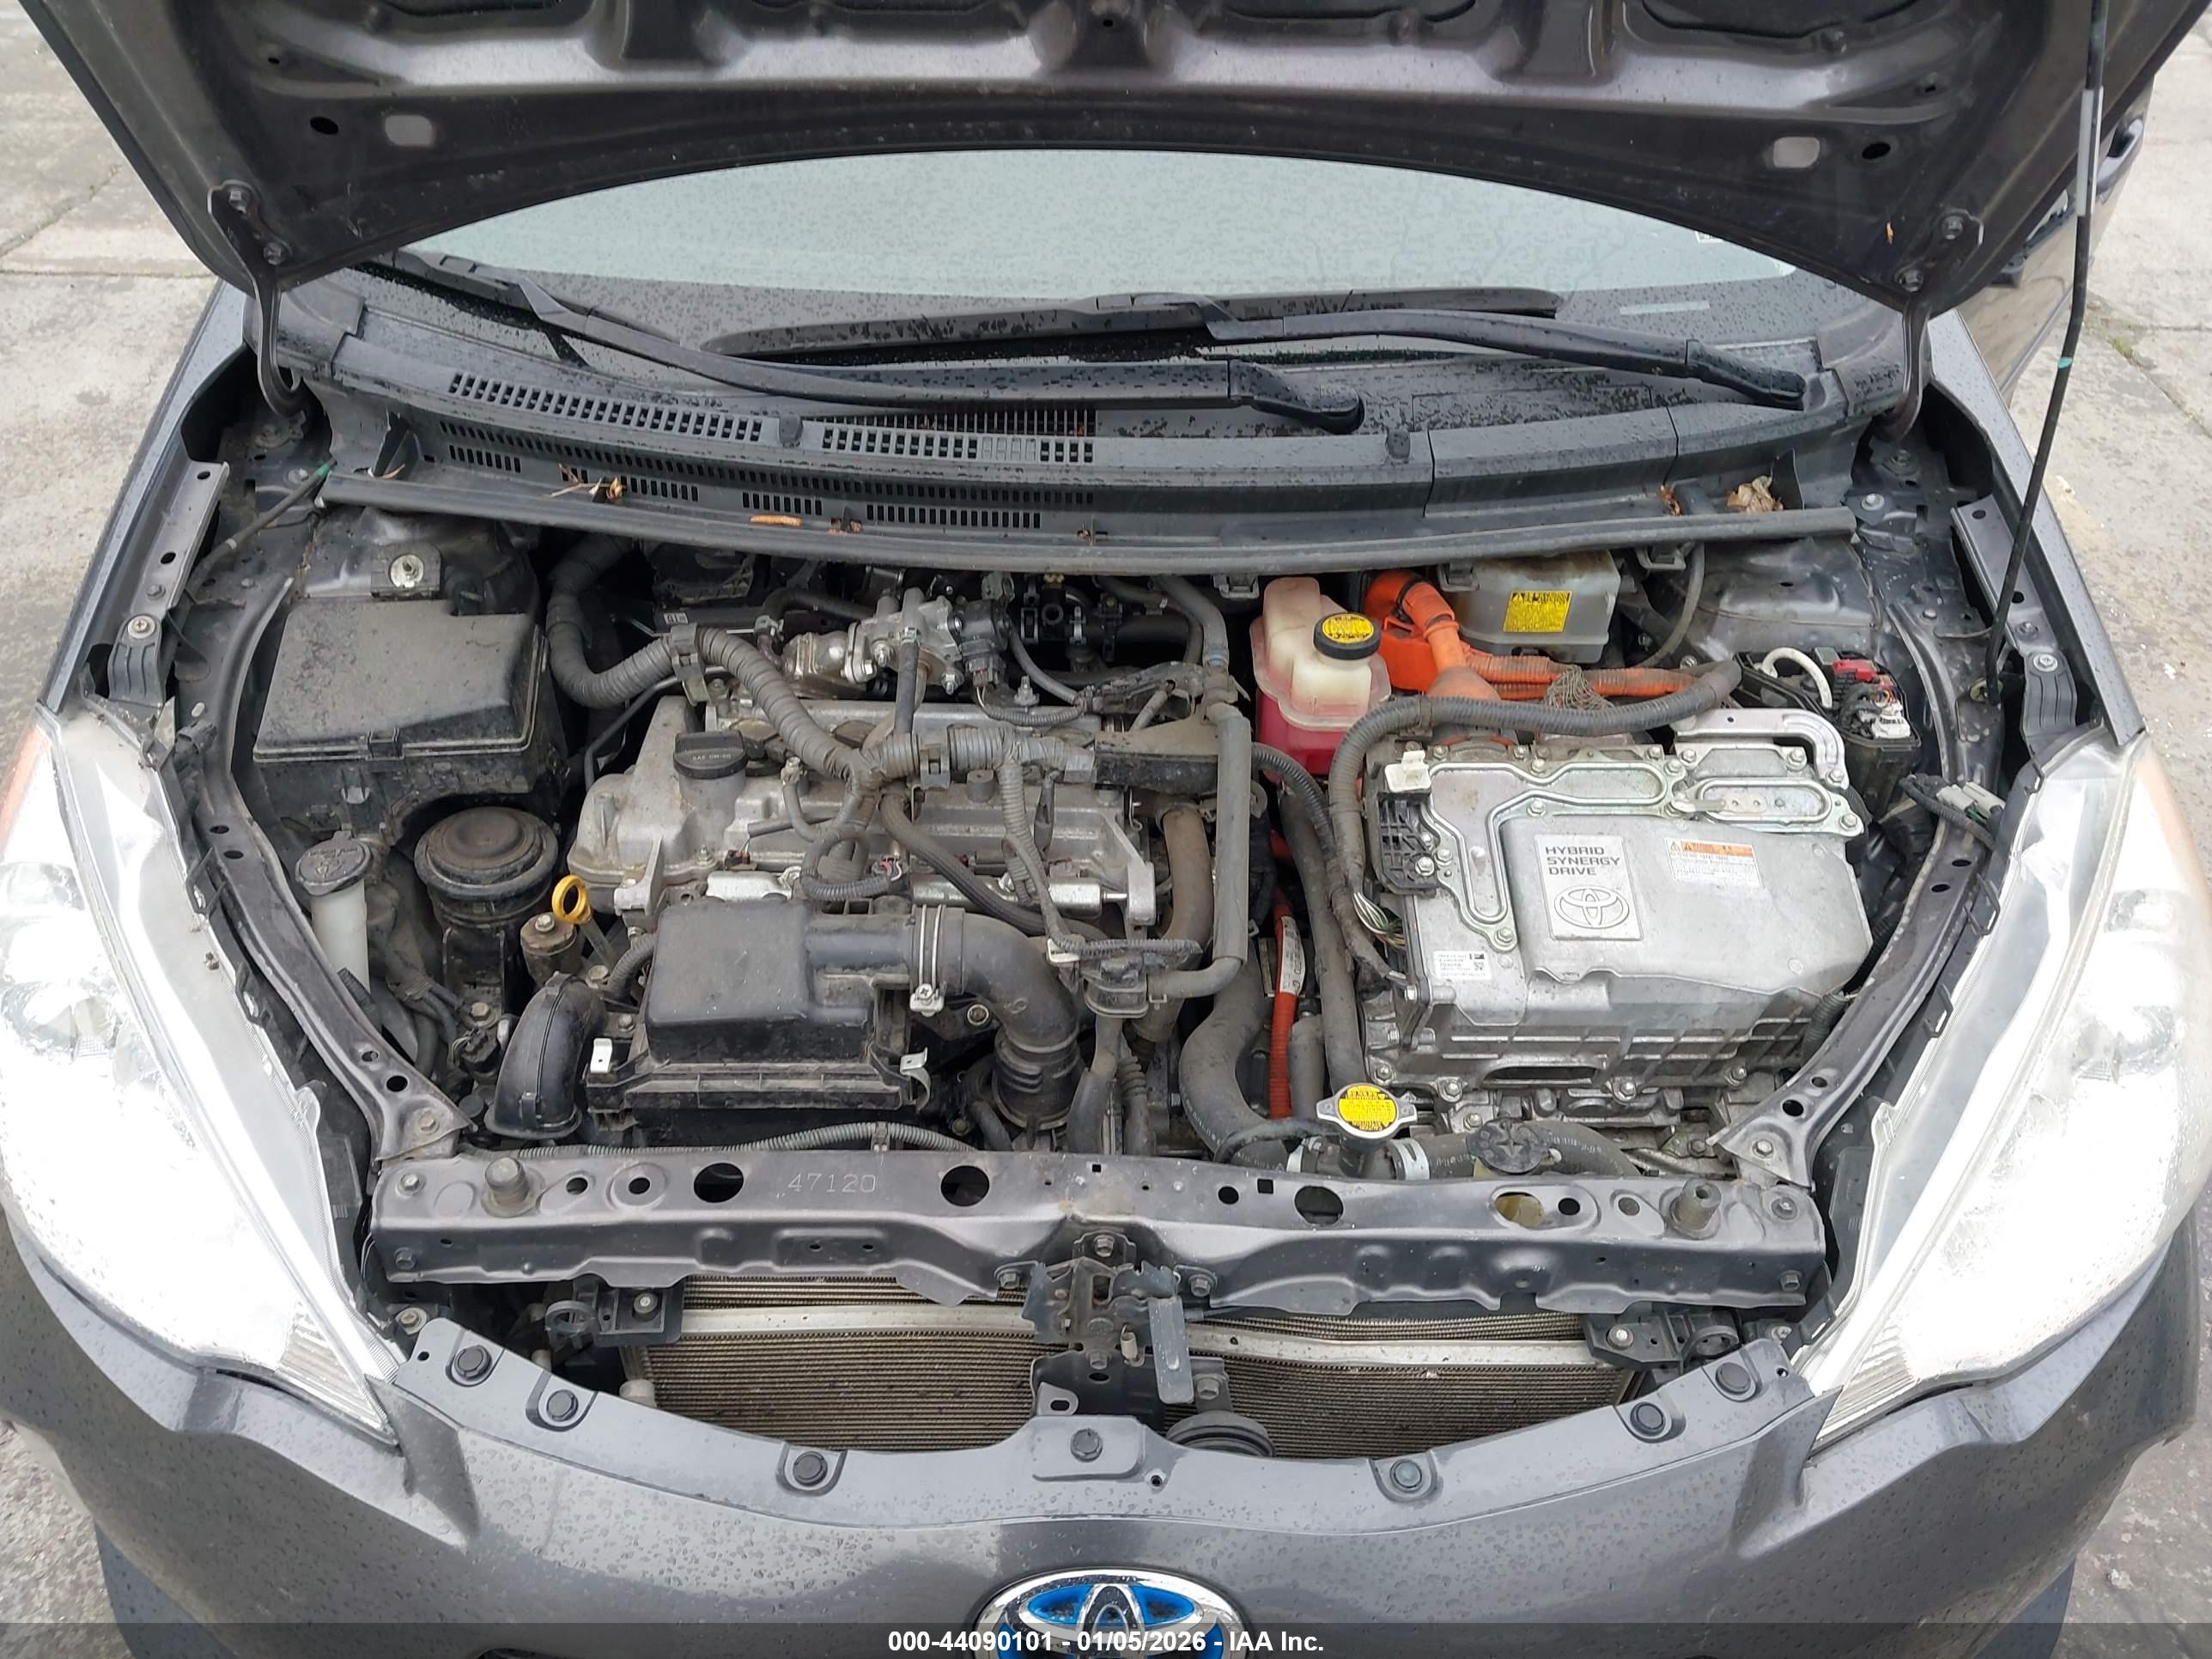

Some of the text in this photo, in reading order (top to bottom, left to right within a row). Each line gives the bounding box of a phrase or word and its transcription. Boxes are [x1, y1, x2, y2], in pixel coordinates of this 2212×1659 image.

[1545, 846, 1605, 855] HYBRID
[1547, 856, 1620, 866] SYNERGY
[1548, 866, 1597, 876] DRIVE
[787, 1172, 877, 1193] 47120
